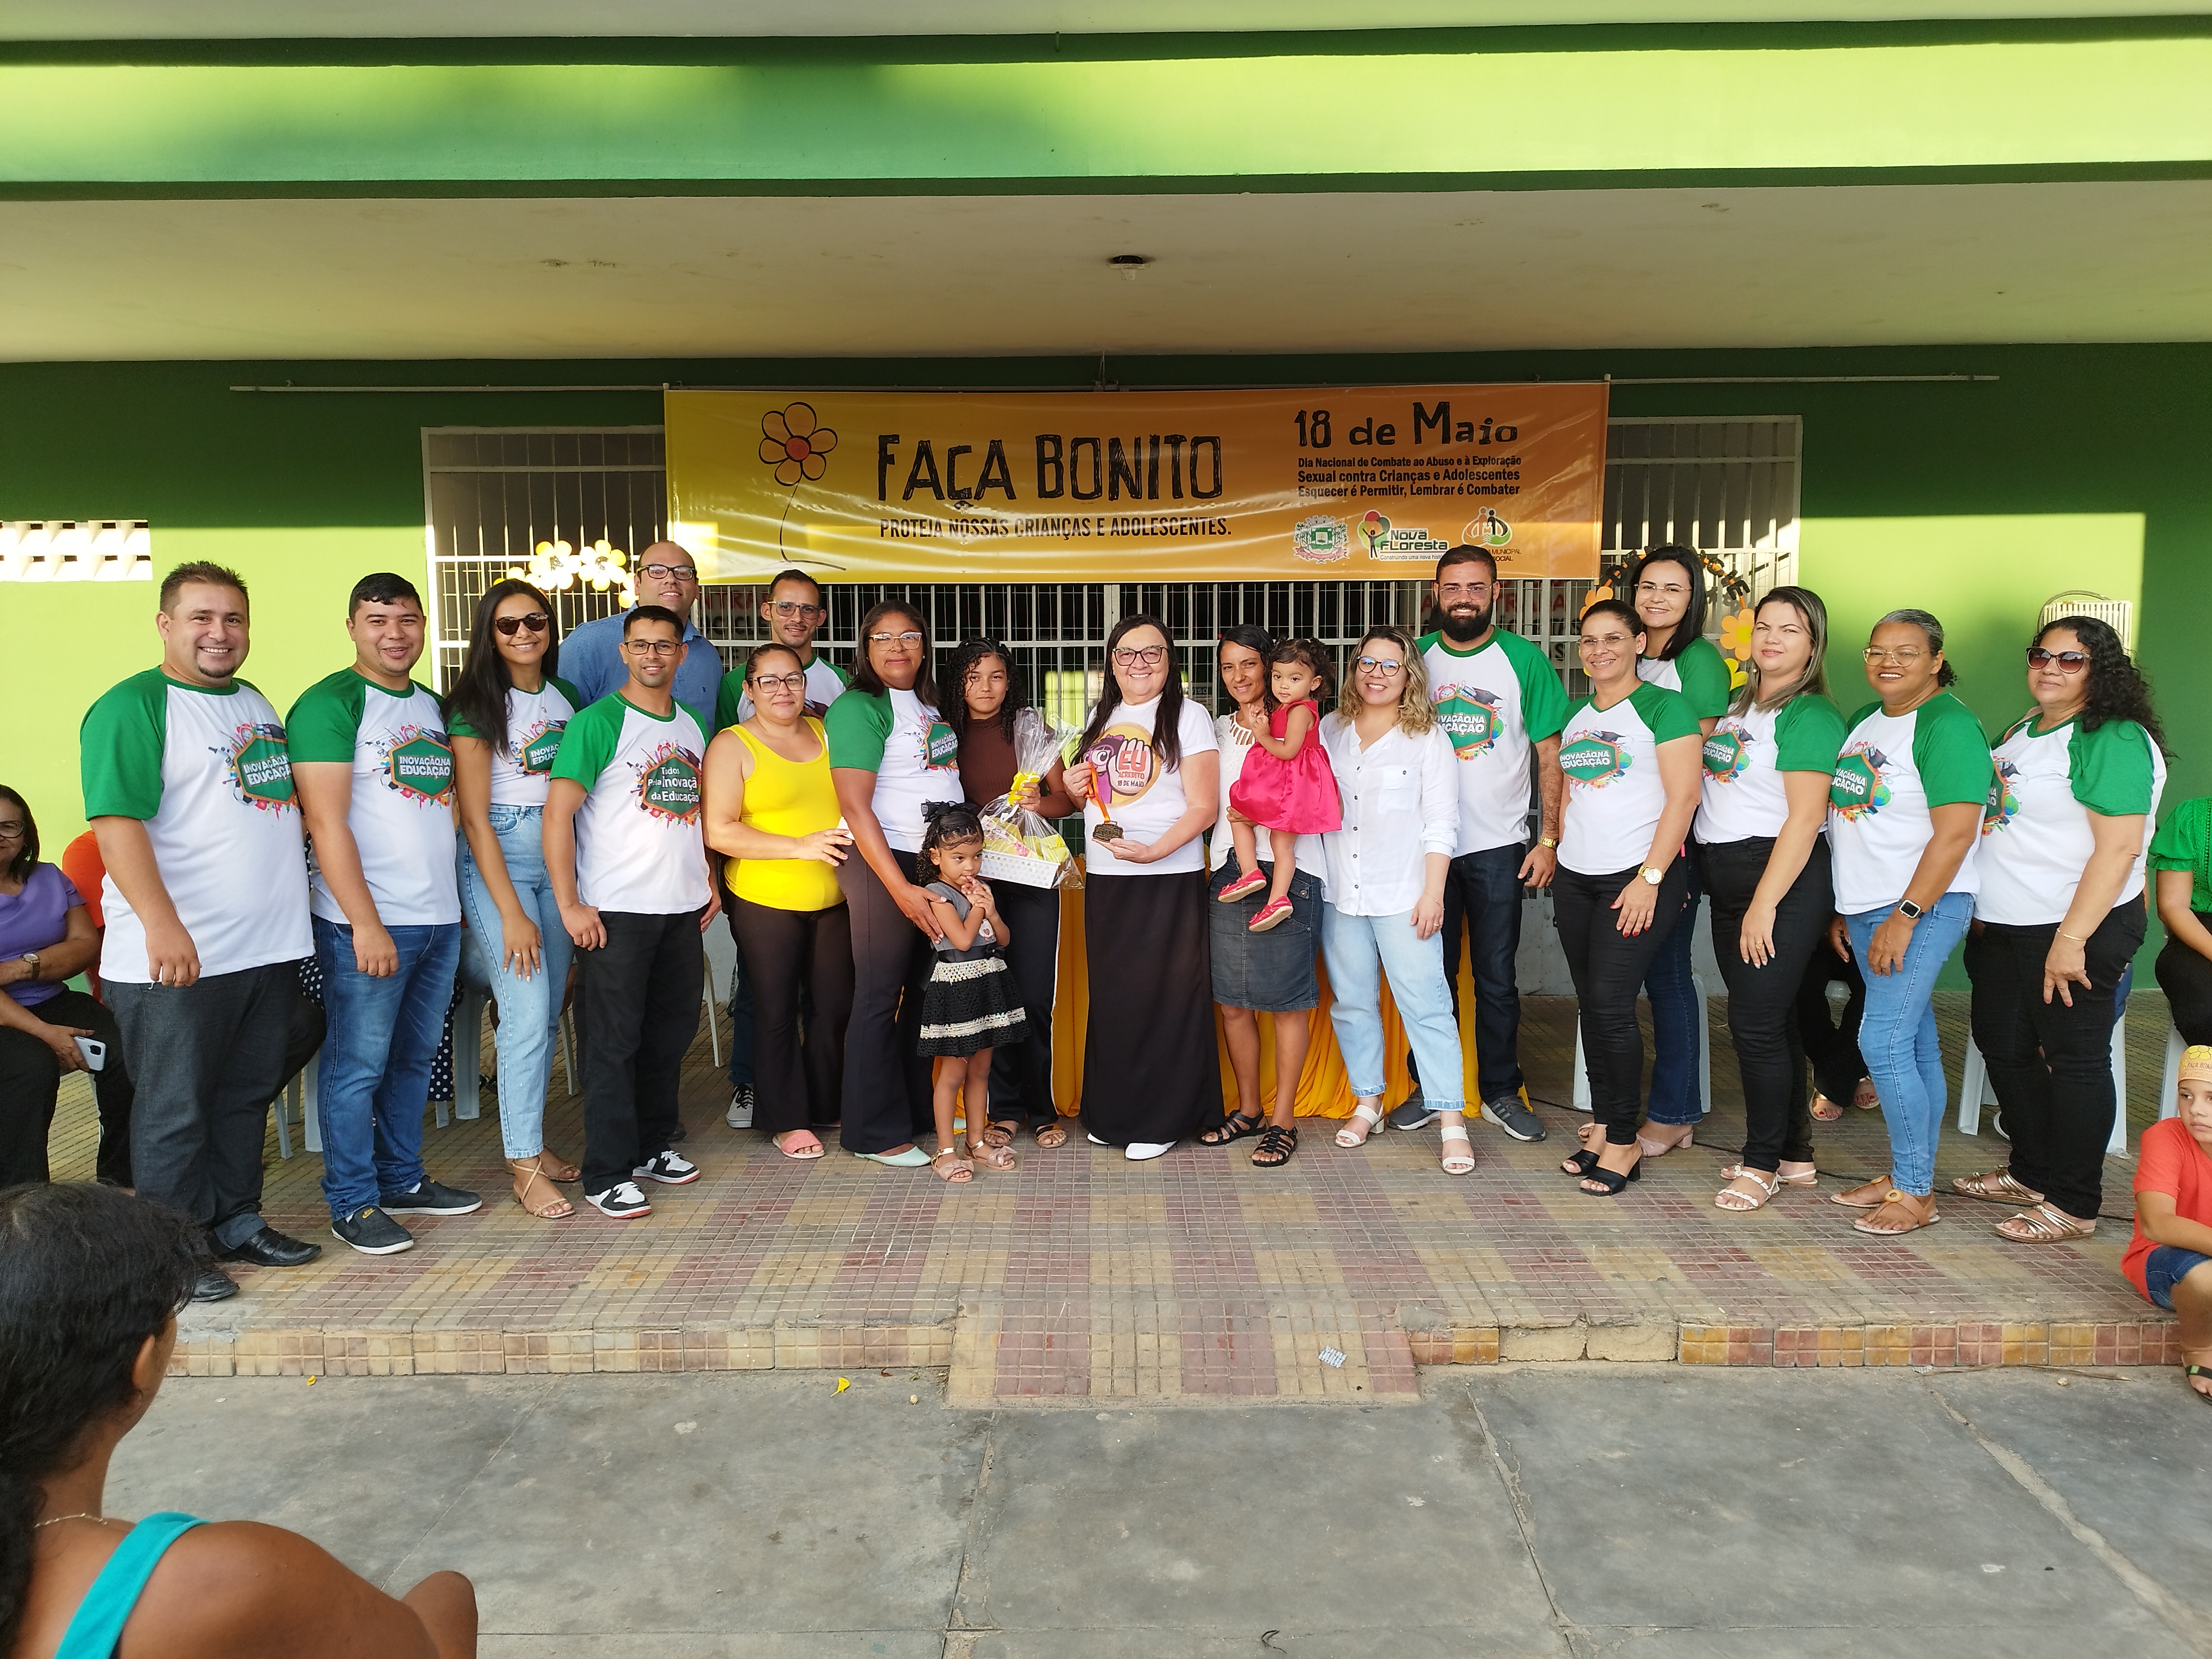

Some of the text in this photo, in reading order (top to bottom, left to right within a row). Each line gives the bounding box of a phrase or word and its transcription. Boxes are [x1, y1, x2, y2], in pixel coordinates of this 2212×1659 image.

[1294, 401, 1517, 448] 18 de Maio
[1298, 457, 1313, 467] Dia
[1316, 457, 1355, 467] Nacional
[1358, 457, 1369, 467] de
[1371, 456, 1411, 467] Combate
[1413, 458, 1425, 466] ao
[1426, 456, 1454, 466] Abuso
[1473, 455, 1521, 467] Exploração
[878, 434, 1222, 509] FAÇA BONITO
[1298, 468, 1520, 484] Sexual contra Crianças e Adolescentes
[1298, 483, 1520, 499] Esquecer é Permitir, Lembrar é Combater
[880, 517, 1232, 540] PROTEJA NOSSAS CRIANÇAS E ADOLESCENTES.
[1118, 749, 1146, 772] EU
[660, 766, 680, 775] Todos
[651, 790, 700, 805] da Educação
